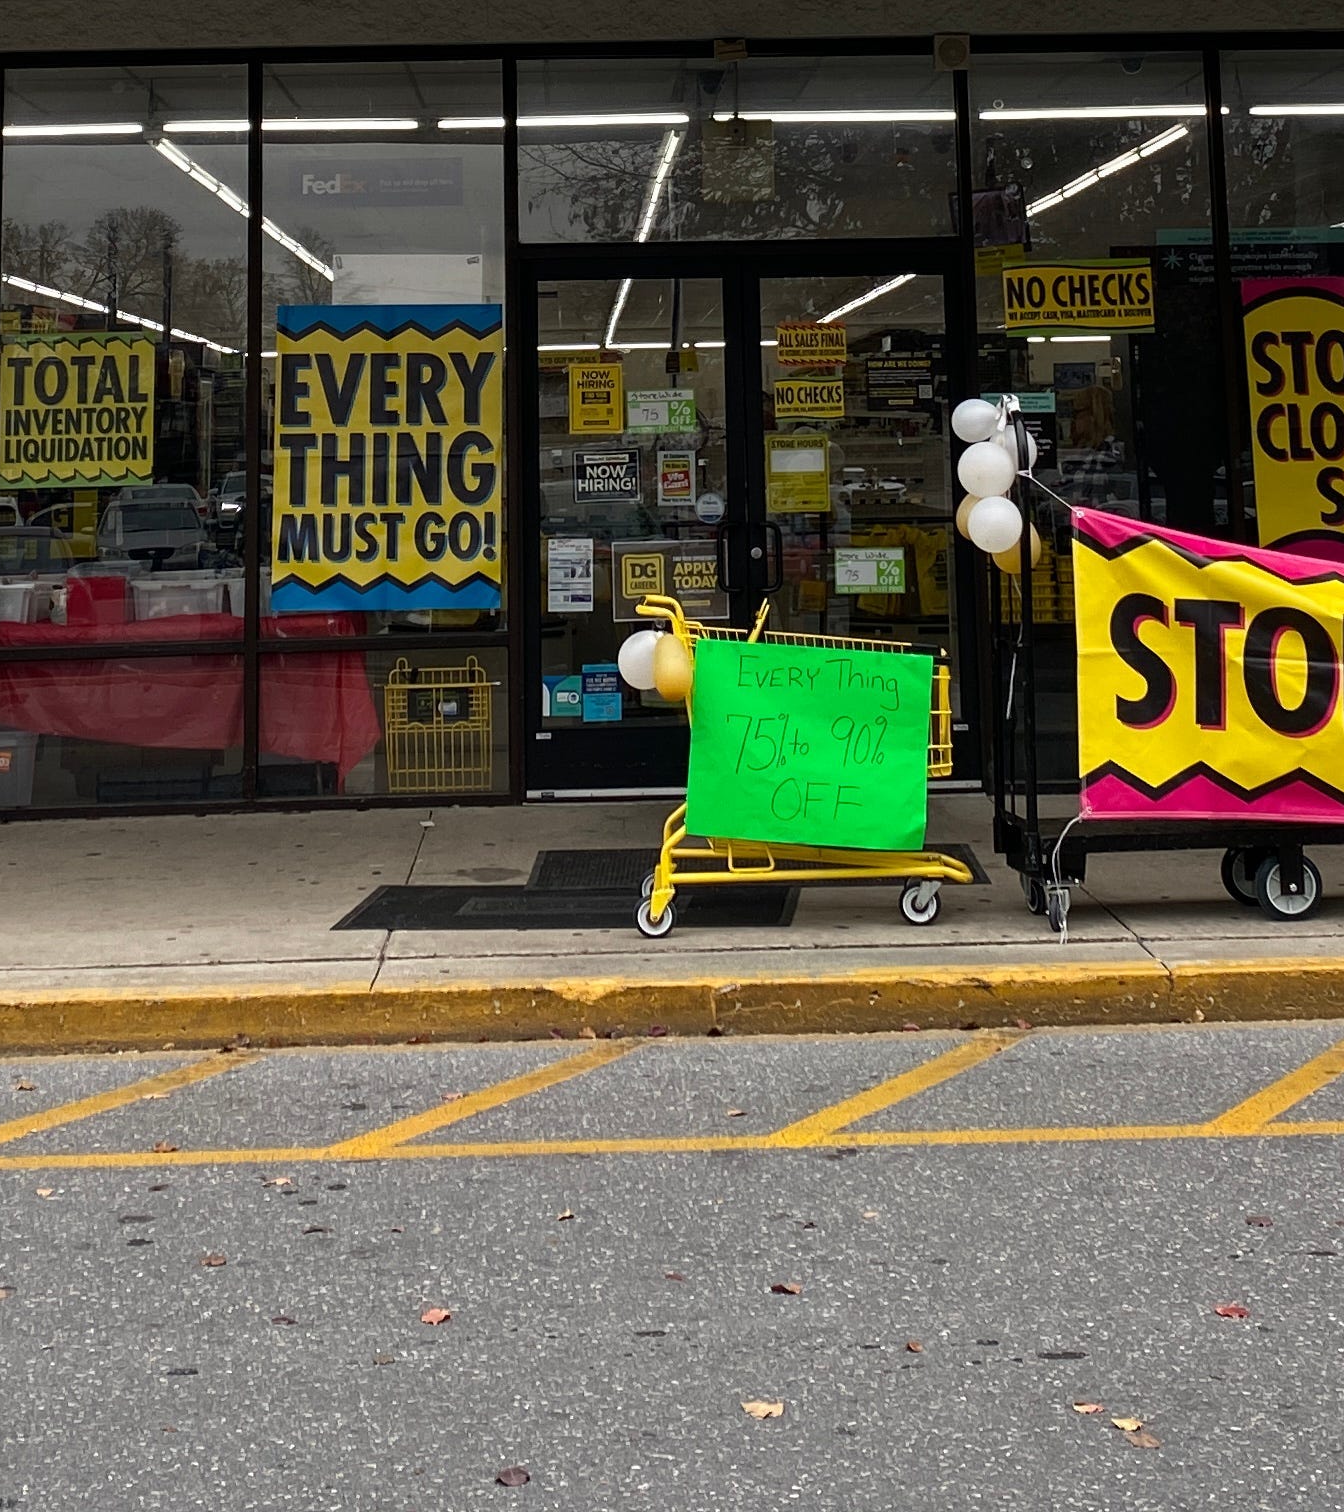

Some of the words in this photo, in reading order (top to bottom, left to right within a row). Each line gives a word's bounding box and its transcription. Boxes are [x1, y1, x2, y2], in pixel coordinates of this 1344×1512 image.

[302, 173, 368, 195] FedEx
[1006, 276, 1046, 309] NO
[1052, 273, 1150, 307] CHECKS
[779, 333, 794, 348] ALL
[795, 333, 819, 348] SALES
[821, 333, 844, 348] FINAL
[8, 355, 149, 406] TOTAL
[577, 380, 615, 389] HIRING
[581, 371, 610, 380] NOW
[280, 352, 496, 427] EVERY
[776, 386, 795, 405] NO
[797, 385, 843, 404] CHECKS
[5, 406, 147, 436] INVENTORY
[670, 416, 691, 425] OFF
[5, 436, 147, 464] LIQUIDATION
[771, 440, 795, 448] STORE
[797, 439, 824, 448] HOURS
[280, 431, 497, 508] THING
[586, 465, 627, 479] NOW
[578, 477, 636, 492] HIRING!
[277, 512, 405, 563] MUST
[415, 511, 497, 562] GO!
[630, 563, 657, 579] DG
[673, 562, 717, 575] APPLY
[672, 575, 718, 588] TODAY
[879, 576, 900, 585] OFF
[737, 654, 821, 690] EVERY
[825, 658, 900, 711] Thing
[726, 713, 790, 775] 75%
[788, 728, 810, 756] to
[831, 715, 888, 768] 90%
[771, 777, 864, 821] OFF
